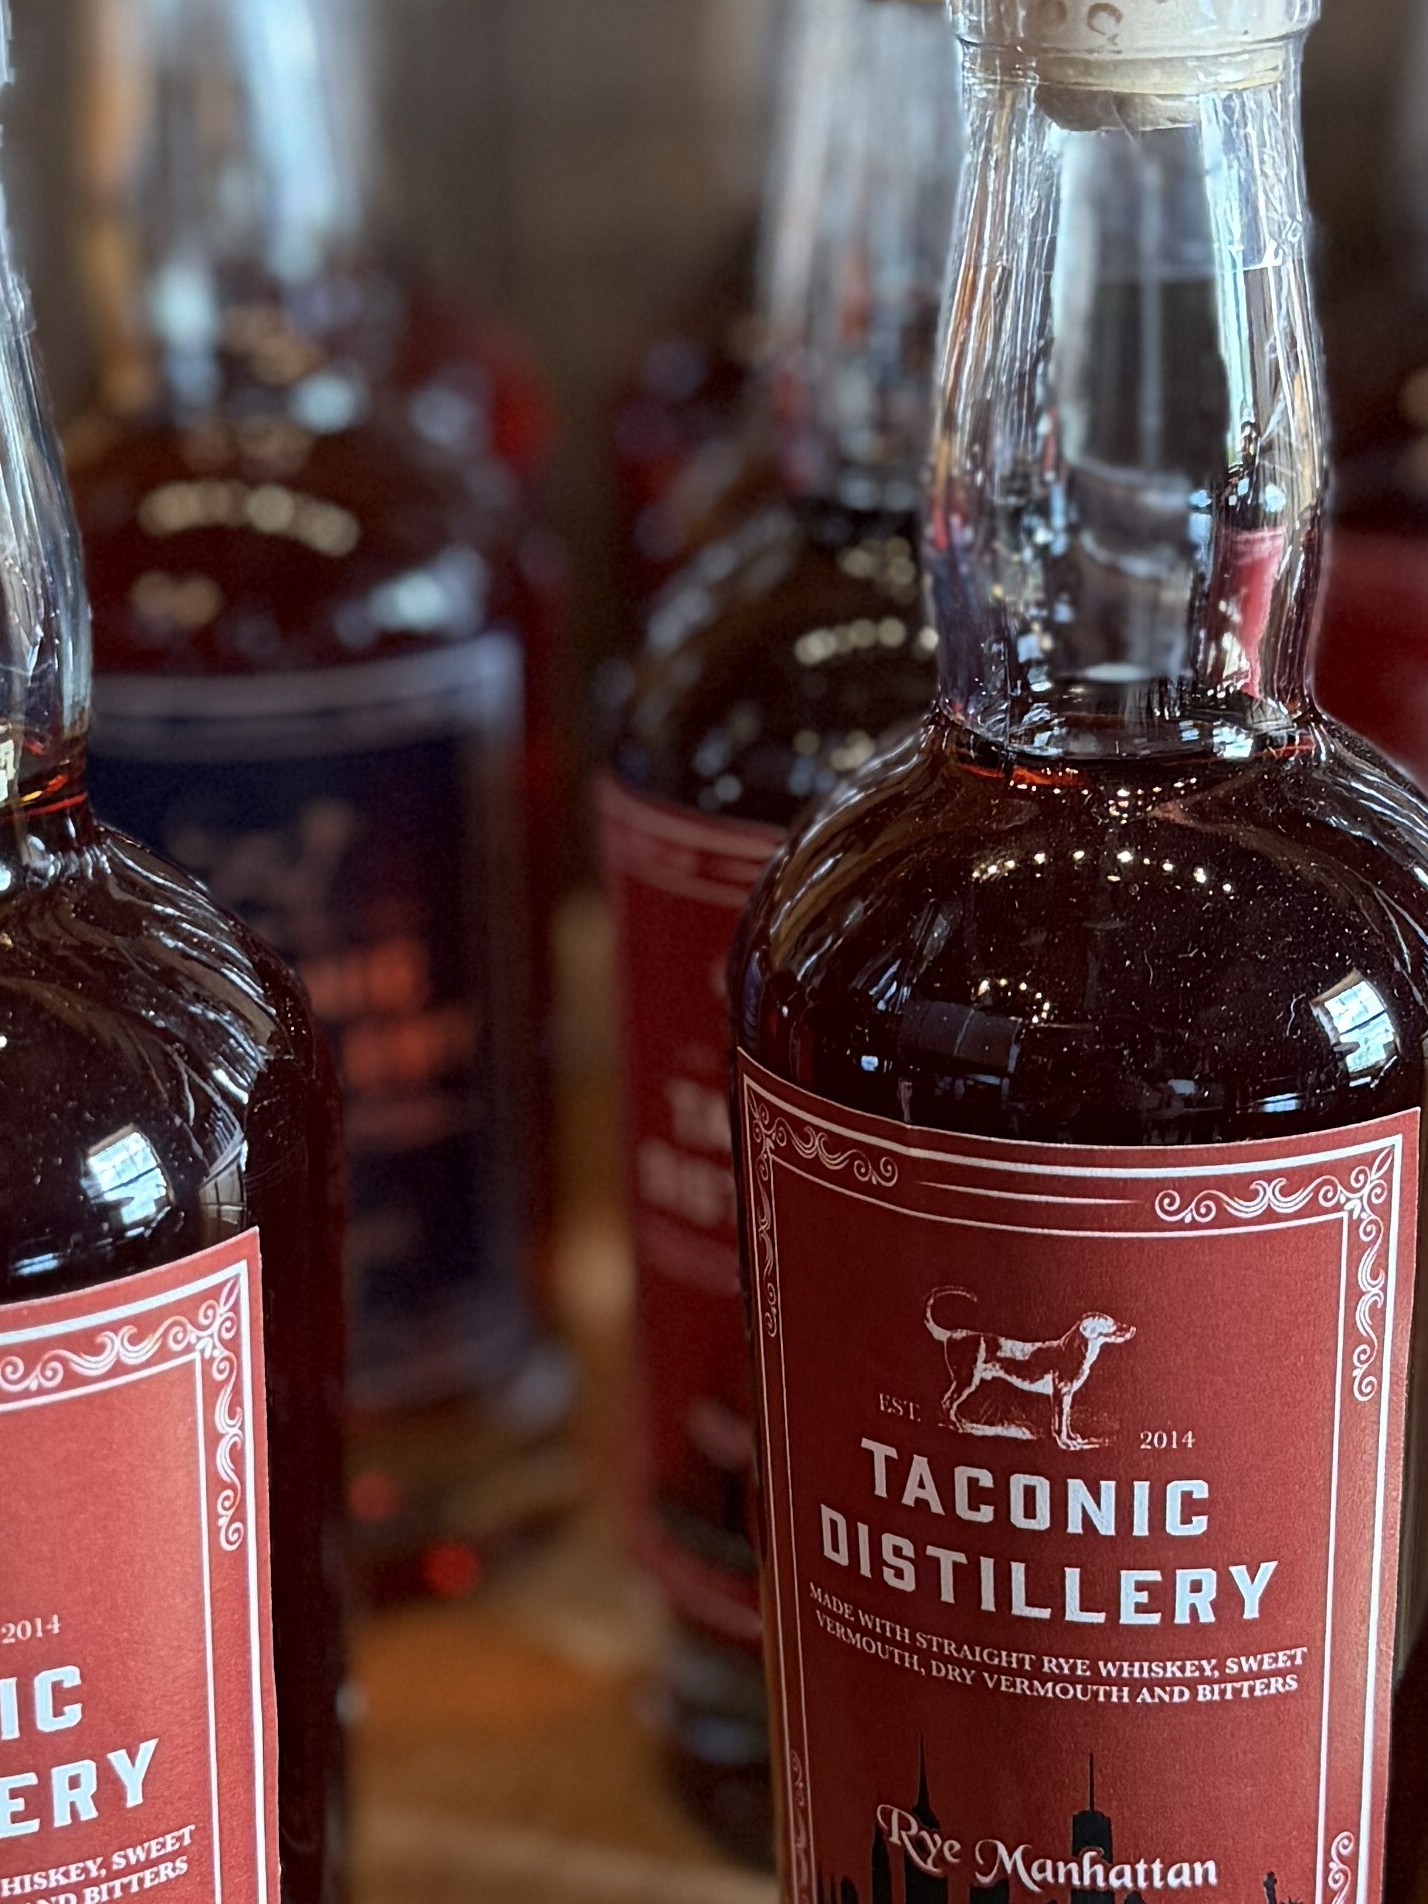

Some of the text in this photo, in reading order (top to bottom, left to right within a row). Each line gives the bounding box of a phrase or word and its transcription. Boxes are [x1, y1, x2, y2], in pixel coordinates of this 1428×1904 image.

[879, 1392, 1195, 1450] EST. 2014
[861, 1438, 1209, 1537] TACONIC
[820, 1504, 1277, 1626] DISTILLERY
[1, 1614, 62, 1645] 2014
[810, 1582, 1308, 1681] MADE WITH STRAIGHT RYE WHISKEY, SWEET
[816, 1609, 1299, 1704] VERMOUTH, DRY VERMOUTH AND BITTERS
[113, 1824, 196, 1871] SWEET
[877, 1804, 1219, 1893] Rye Manhattan
